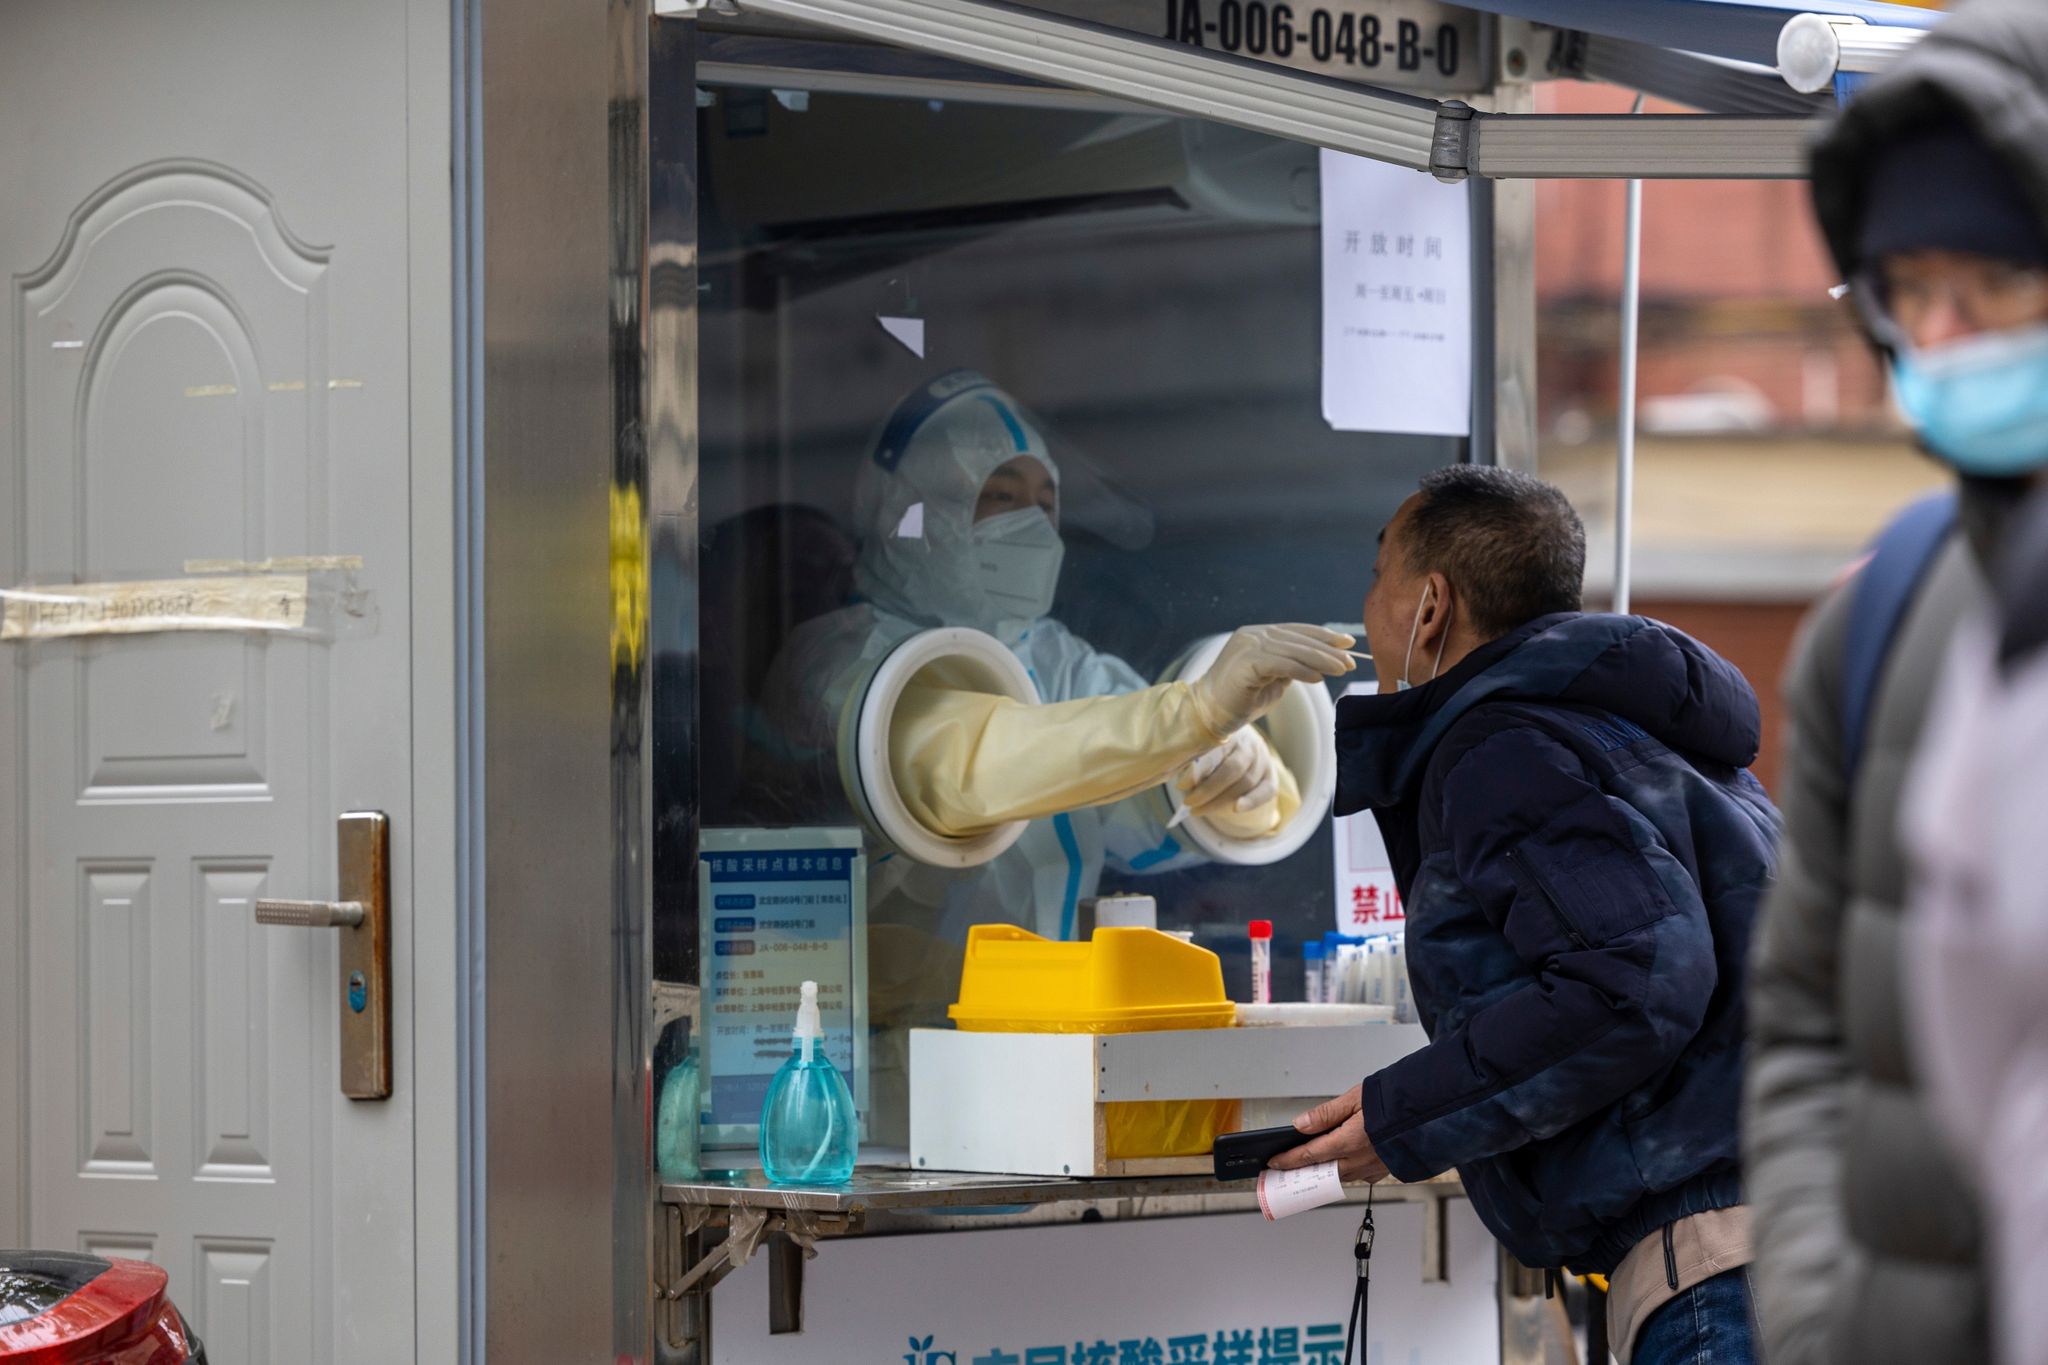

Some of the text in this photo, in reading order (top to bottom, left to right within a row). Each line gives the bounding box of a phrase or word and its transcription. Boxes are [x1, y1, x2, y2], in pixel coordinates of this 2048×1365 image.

[1343, 230, 1443, 261] 开放时间
[712, 857, 843, 873] 核酸采样点基本信息
[1352, 885, 1407, 924] 禁止
